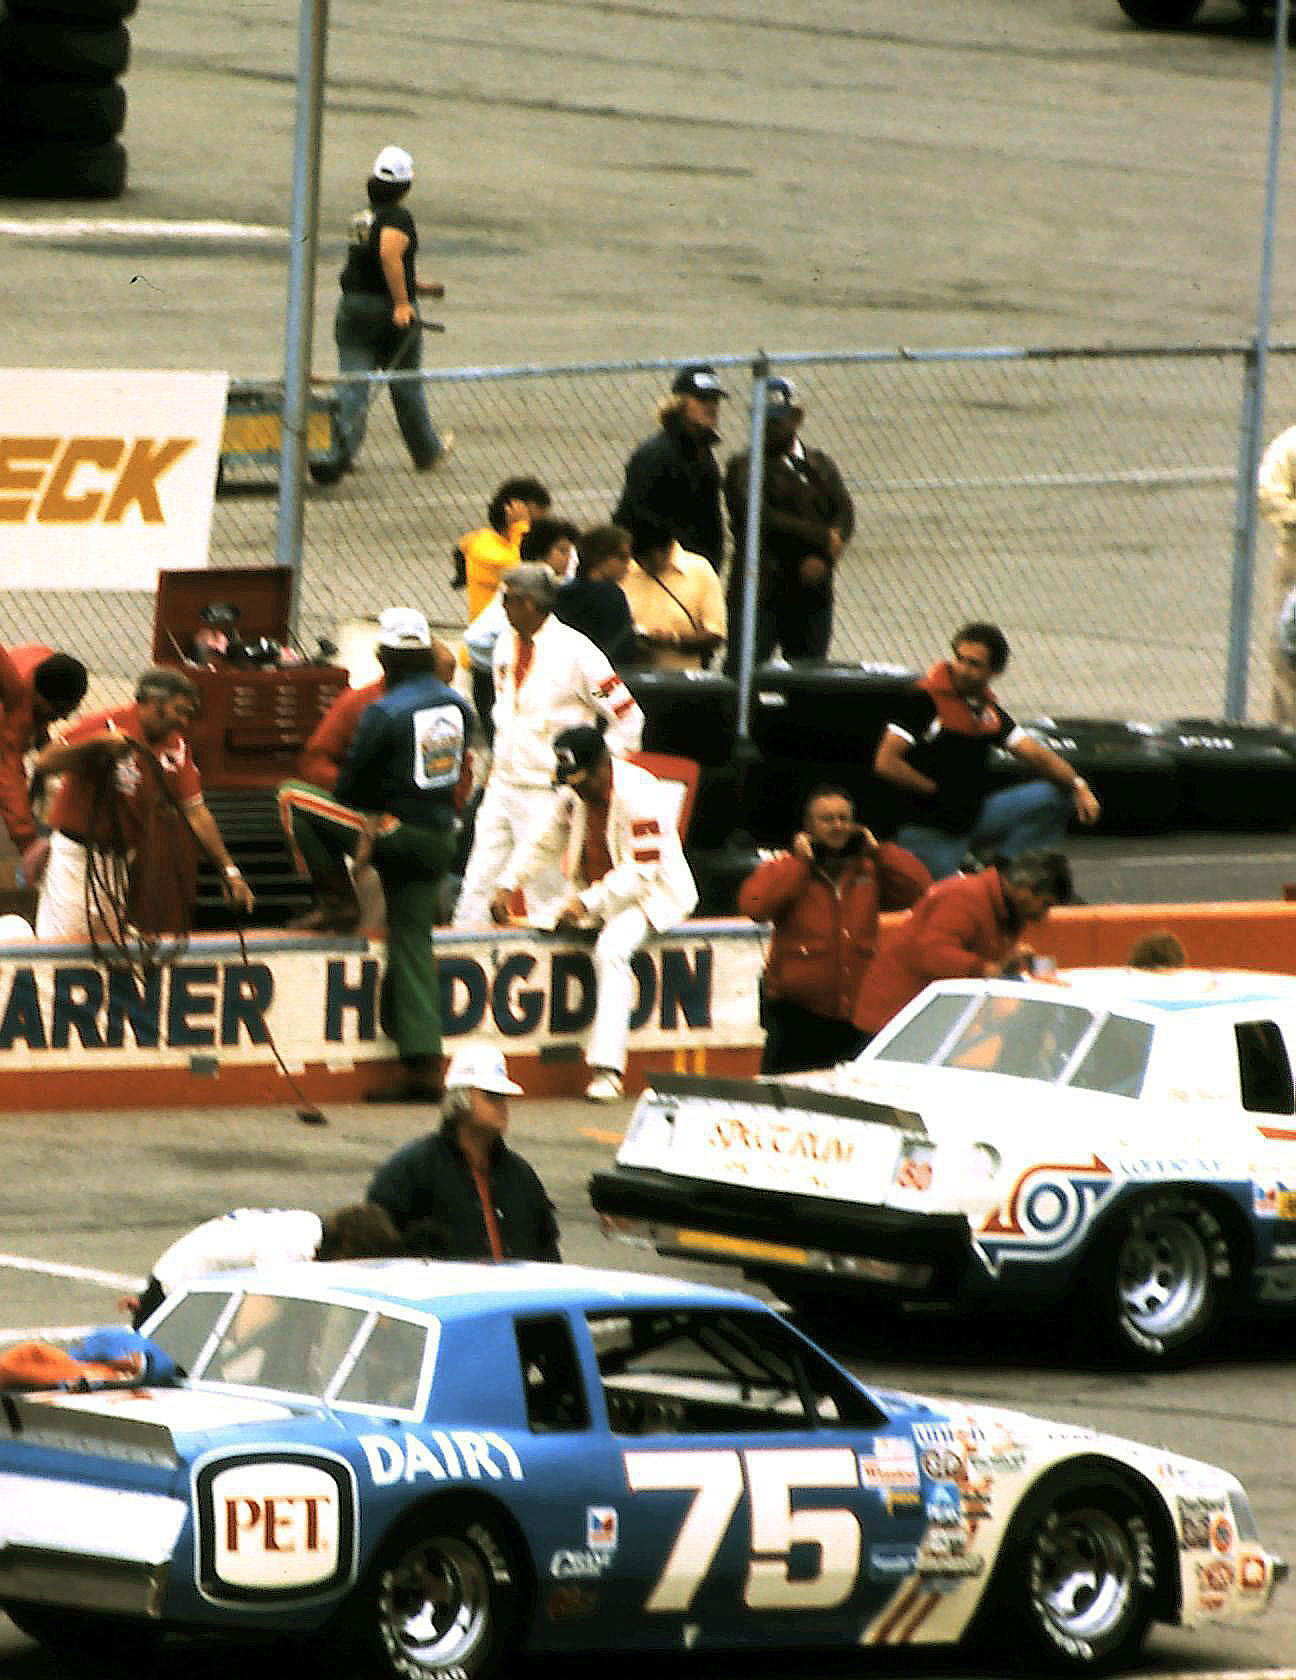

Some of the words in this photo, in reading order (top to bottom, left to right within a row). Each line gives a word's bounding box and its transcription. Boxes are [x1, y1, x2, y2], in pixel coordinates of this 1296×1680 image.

[325, 940, 713, 1043] HDGDON
[359, 1430, 525, 1486] DAIRY
[223, 1495, 331, 1555] PET
[621, 1447, 863, 1613] 75
